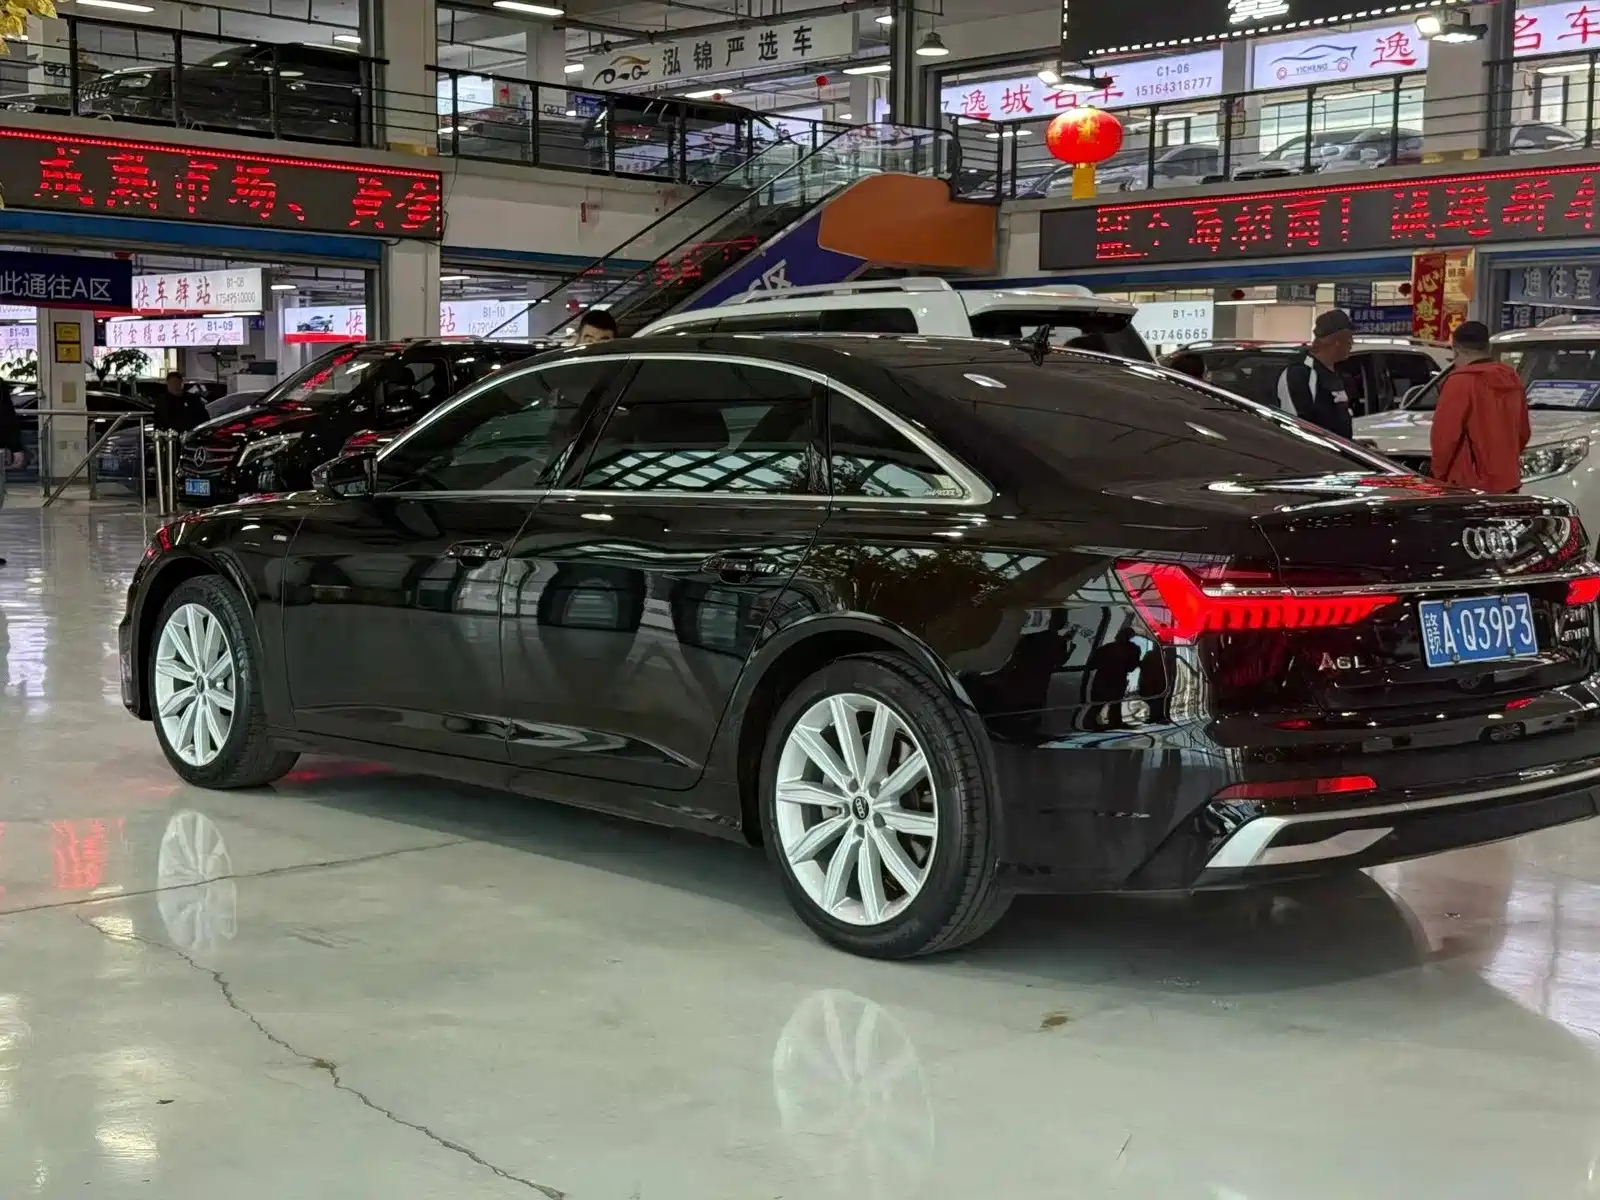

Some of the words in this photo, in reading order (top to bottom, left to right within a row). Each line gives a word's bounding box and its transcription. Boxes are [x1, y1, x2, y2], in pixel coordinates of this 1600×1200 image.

[662, 25, 813, 76] 泓锦严选车
[1369, 31, 1417, 68] 逸
[1156, 63, 1190, 76] C1-06
[1135, 76, 1213, 97] 15164318777
[0, 270, 112, 301] 此通往A区
[1523, 265, 1600, 300] 通往室
[483, 306, 506, 318] B1-10
[1172, 308, 1206, 319] B1-13
[207, 320, 233, 331] B1-09
[1138, 327, 1209, 341] 43746665
[1317, 652, 1367, 671] A6L
